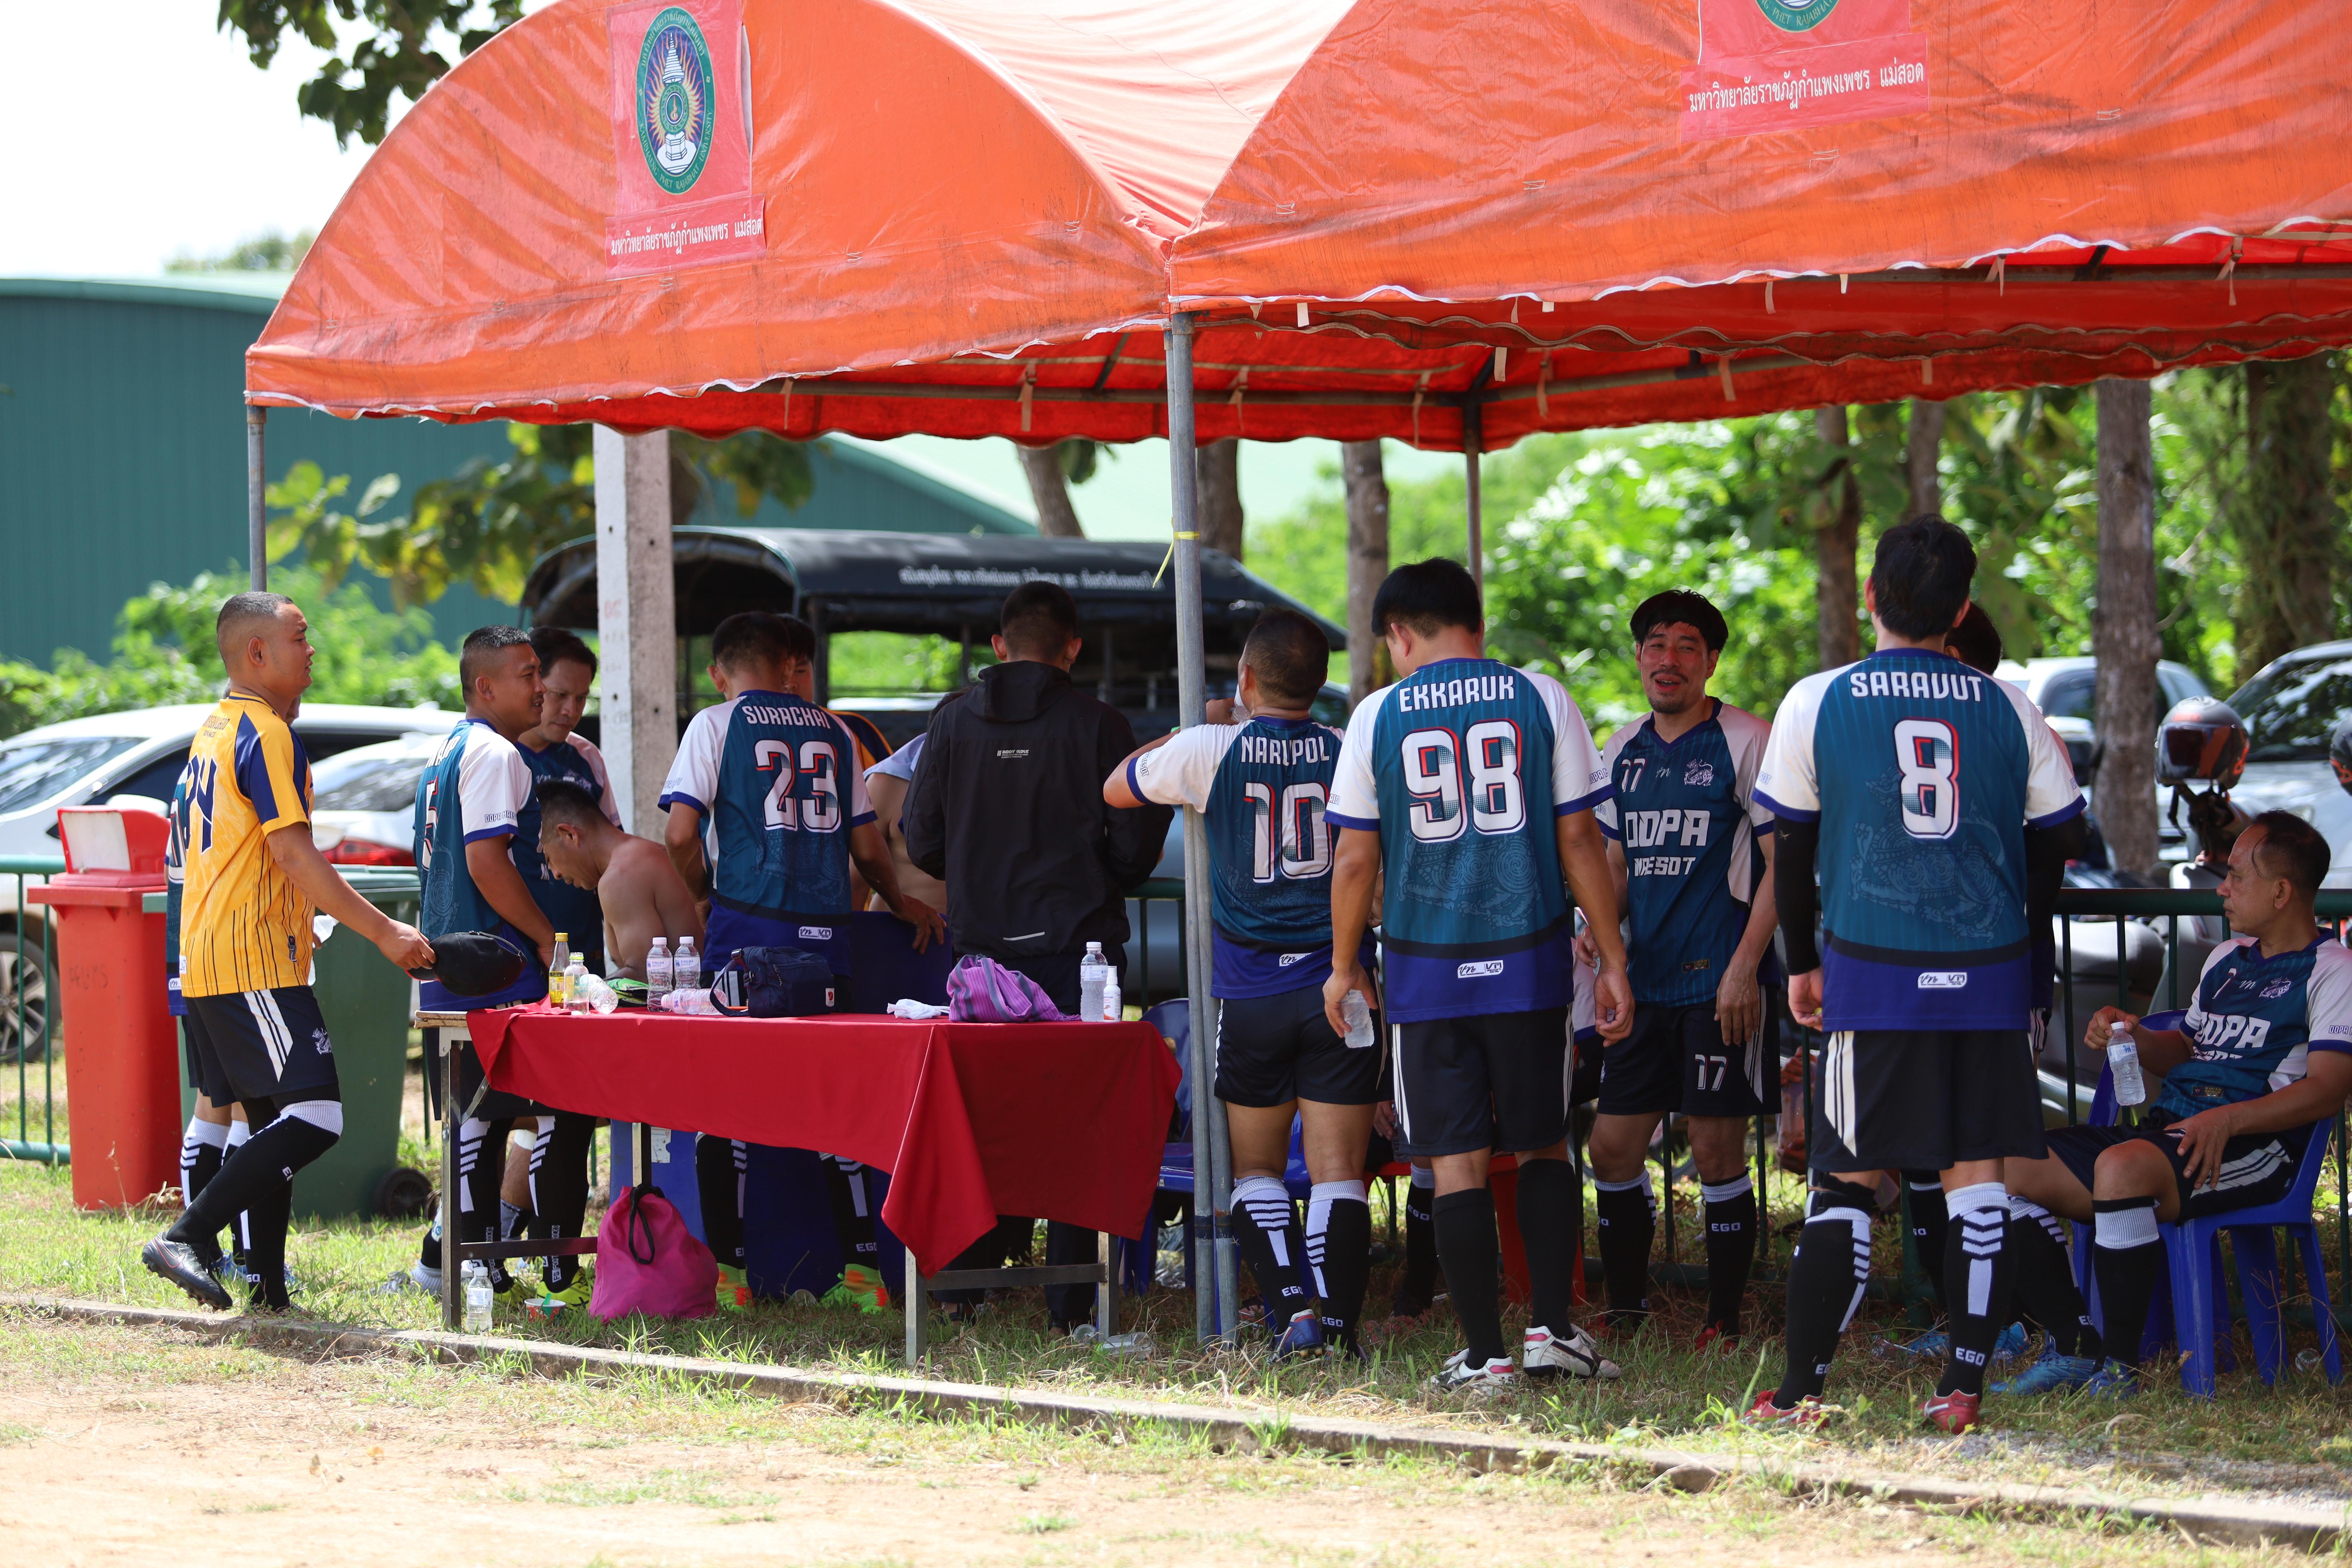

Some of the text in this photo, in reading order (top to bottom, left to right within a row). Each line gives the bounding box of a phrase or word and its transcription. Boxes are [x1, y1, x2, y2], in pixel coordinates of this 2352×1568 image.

[1772, 7, 1792, 24] PHET
[1689, 57, 1924, 113] มหาวิทยาลัยราชภัฏกำแพงเพชร แม่สอด
[698, 110, 713, 162] UNIVERSITY
[611, 214, 763, 256] มหาวิทยาลัยราชภัฏกำแพงเพชร แม่สอด
[1399, 674, 1515, 713] EKKARUK
[1850, 671, 1982, 702] SARAVUT
[742, 705, 831, 729] SURACHAI
[755, 739, 842, 833] 23
[1401, 718, 1527, 843] 98
[1621, 757, 1647, 793] 17
[1893, 716, 1959, 839] 8
[484, 812, 502, 822] DOPA
[1244, 781, 1334, 883] 10
[1625, 808, 1711, 848] DOPA
[1634, 856, 1696, 877] MAESOT
[2328, 1025, 2349, 1034] DOPA
[1695, 1054, 1728, 1091] 17
[1407, 1204, 1430, 1220] EGO
[1711, 1222, 1741, 1232] EGO
[551, 1225, 560, 1239] OCKS
[1321, 1316, 1343, 1328] EGO
[1955, 1347, 1986, 1366] EGO
